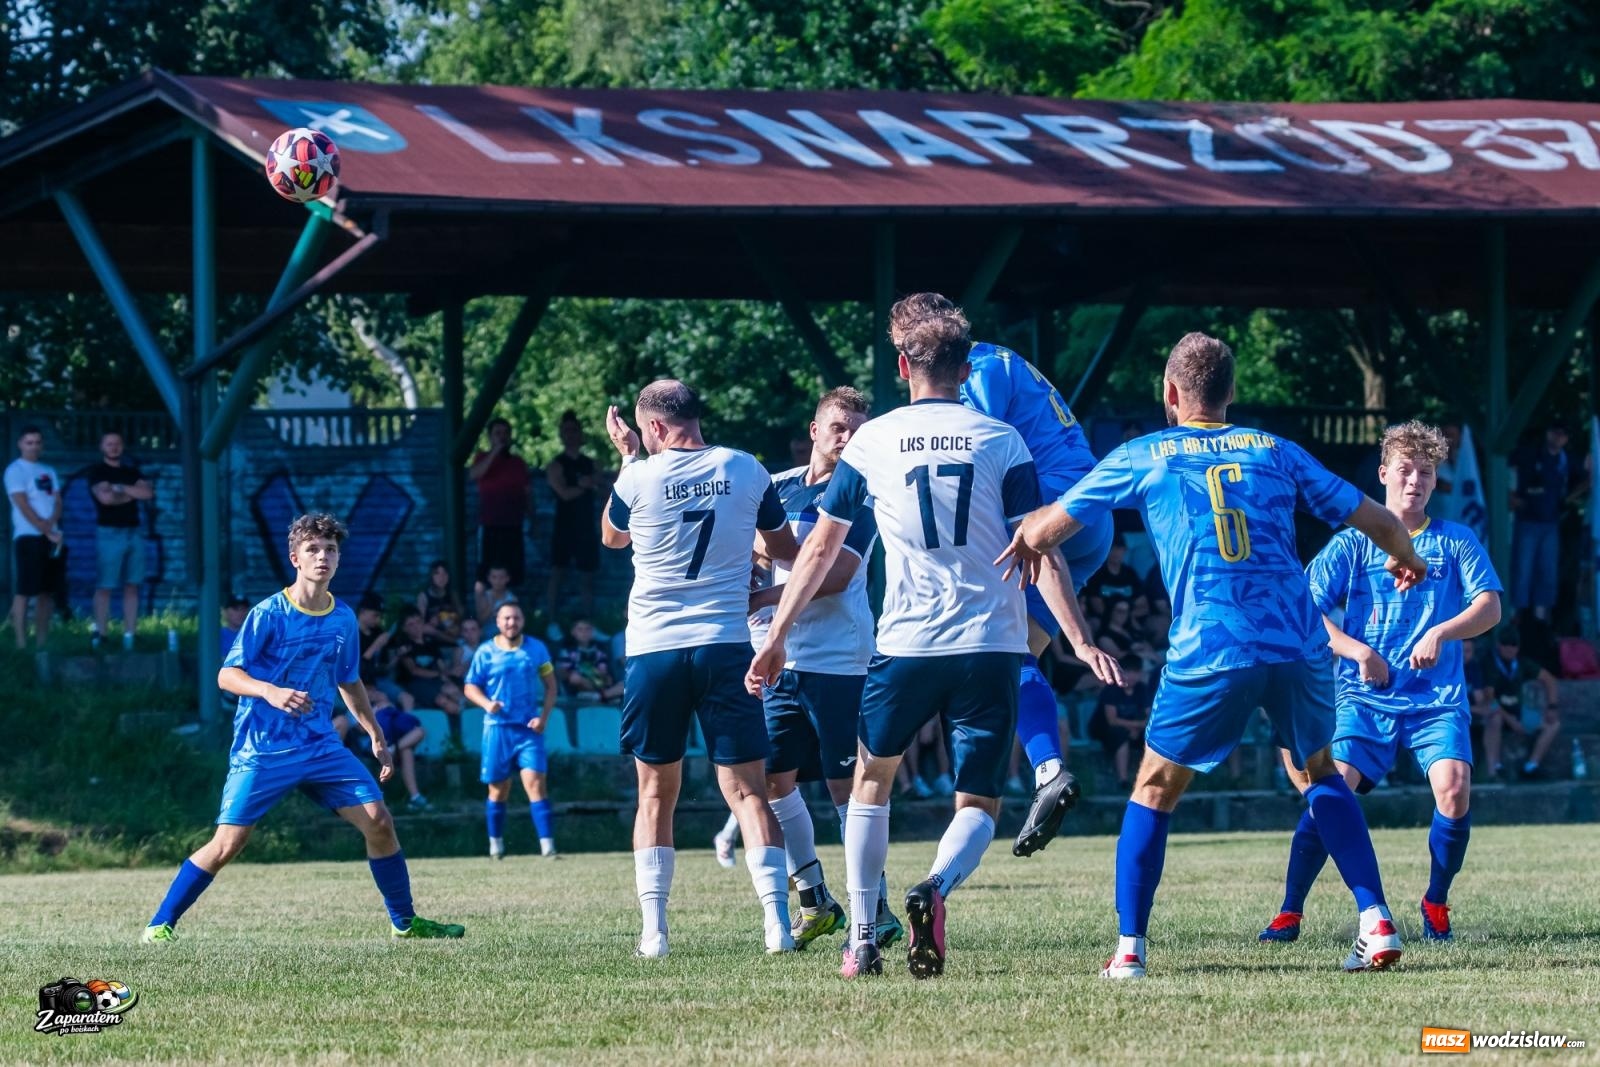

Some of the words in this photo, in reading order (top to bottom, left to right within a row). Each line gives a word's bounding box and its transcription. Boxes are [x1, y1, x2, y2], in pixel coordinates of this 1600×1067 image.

[900, 437, 925, 453] LKS
[931, 436, 973, 452] OCICE
[665, 484, 689, 500] LKS
[694, 480, 731, 497] OCICE
[905, 463, 975, 550] 17
[1205, 462, 1252, 564] 6
[682, 509, 716, 581] 7
